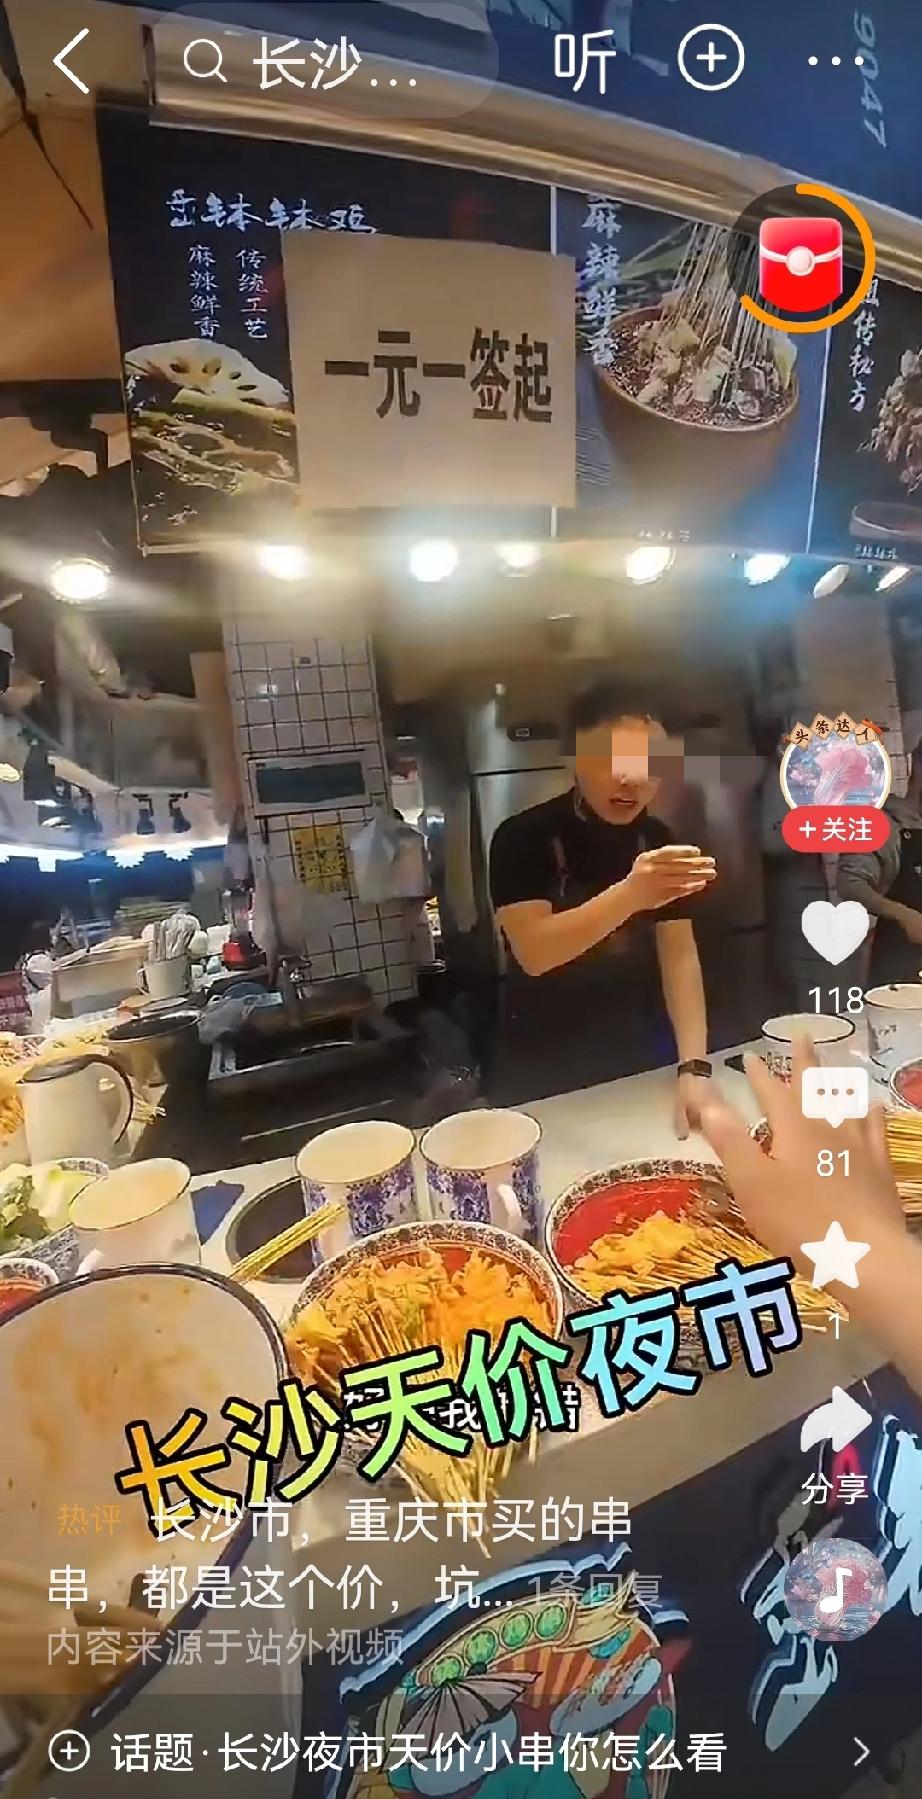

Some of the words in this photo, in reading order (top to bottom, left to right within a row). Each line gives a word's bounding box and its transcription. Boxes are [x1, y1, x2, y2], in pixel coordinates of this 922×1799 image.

[189, 245, 222, 339] 麻辣鲜香
[235, 249, 269, 339] 传统工艺
[324, 326, 553, 423] 一元一签起
